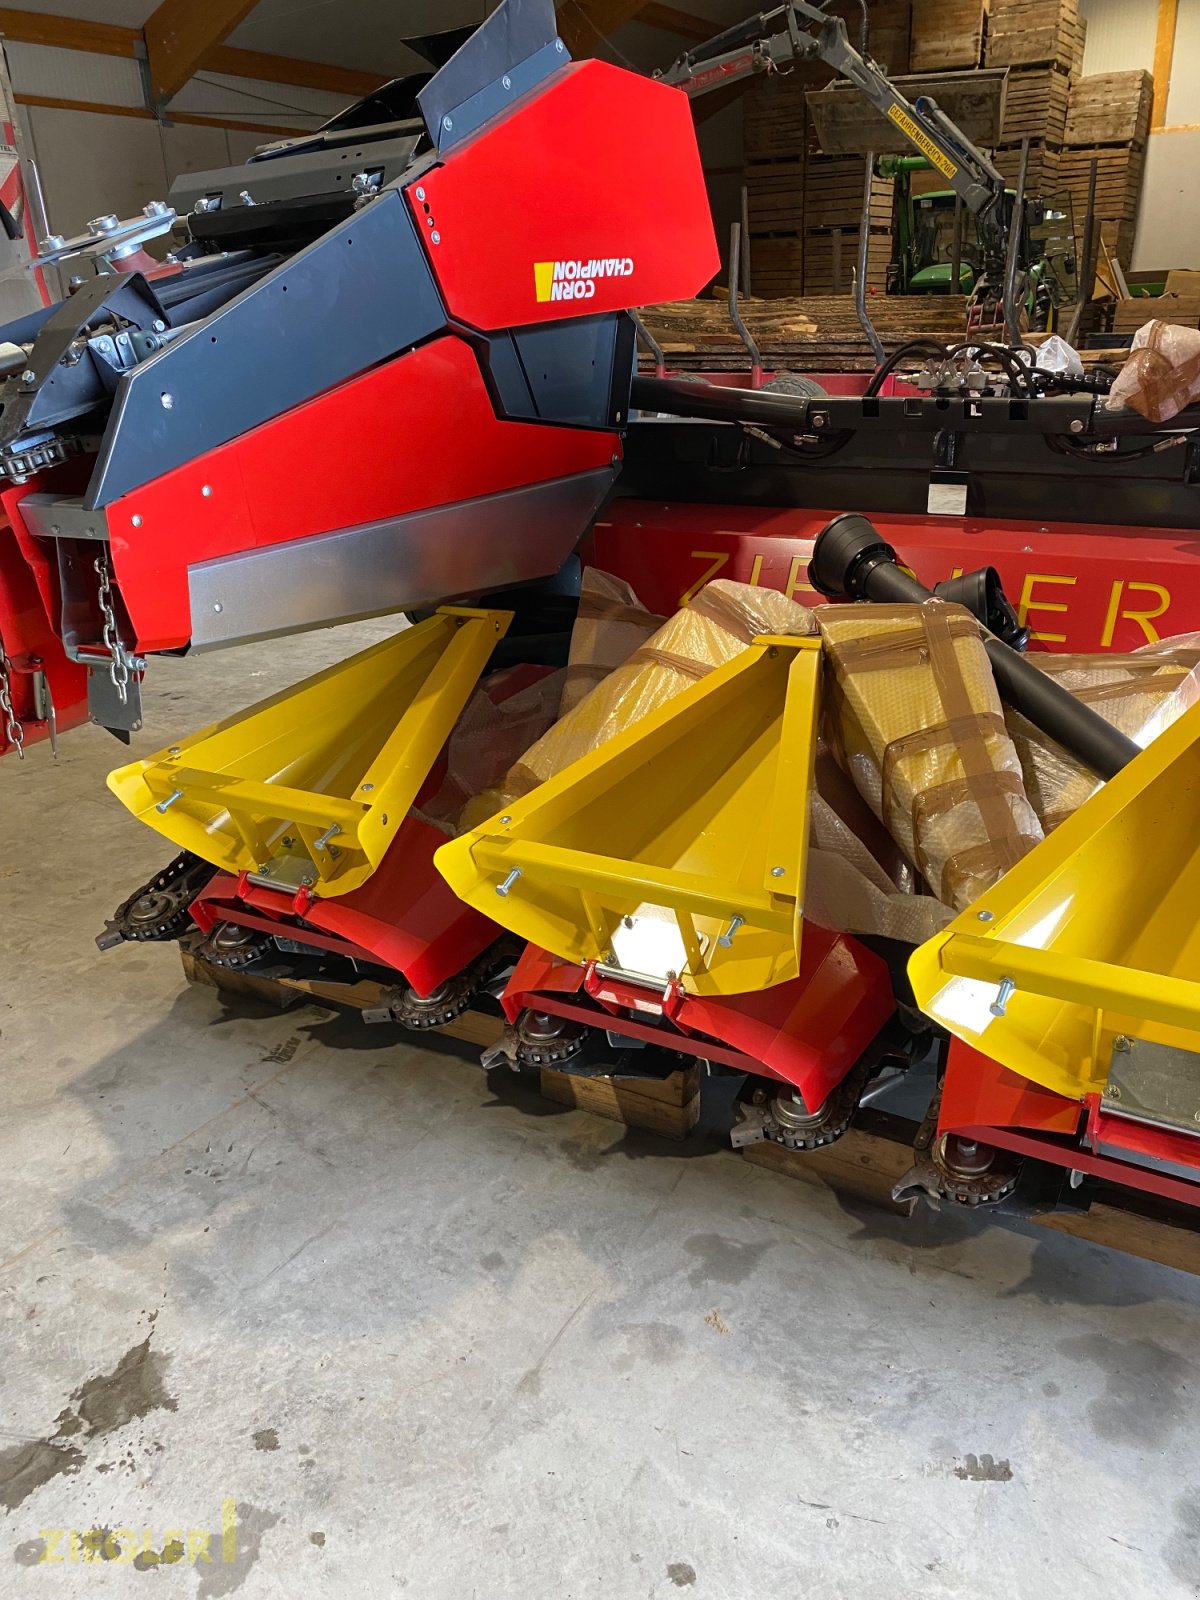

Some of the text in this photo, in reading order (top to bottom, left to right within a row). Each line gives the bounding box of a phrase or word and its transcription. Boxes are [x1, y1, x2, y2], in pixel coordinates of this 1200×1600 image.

[889, 105, 942, 164] GEFAHRENBEREICH
[553, 258, 634, 280] CHAMPION
[551, 280, 595, 301] CORN
